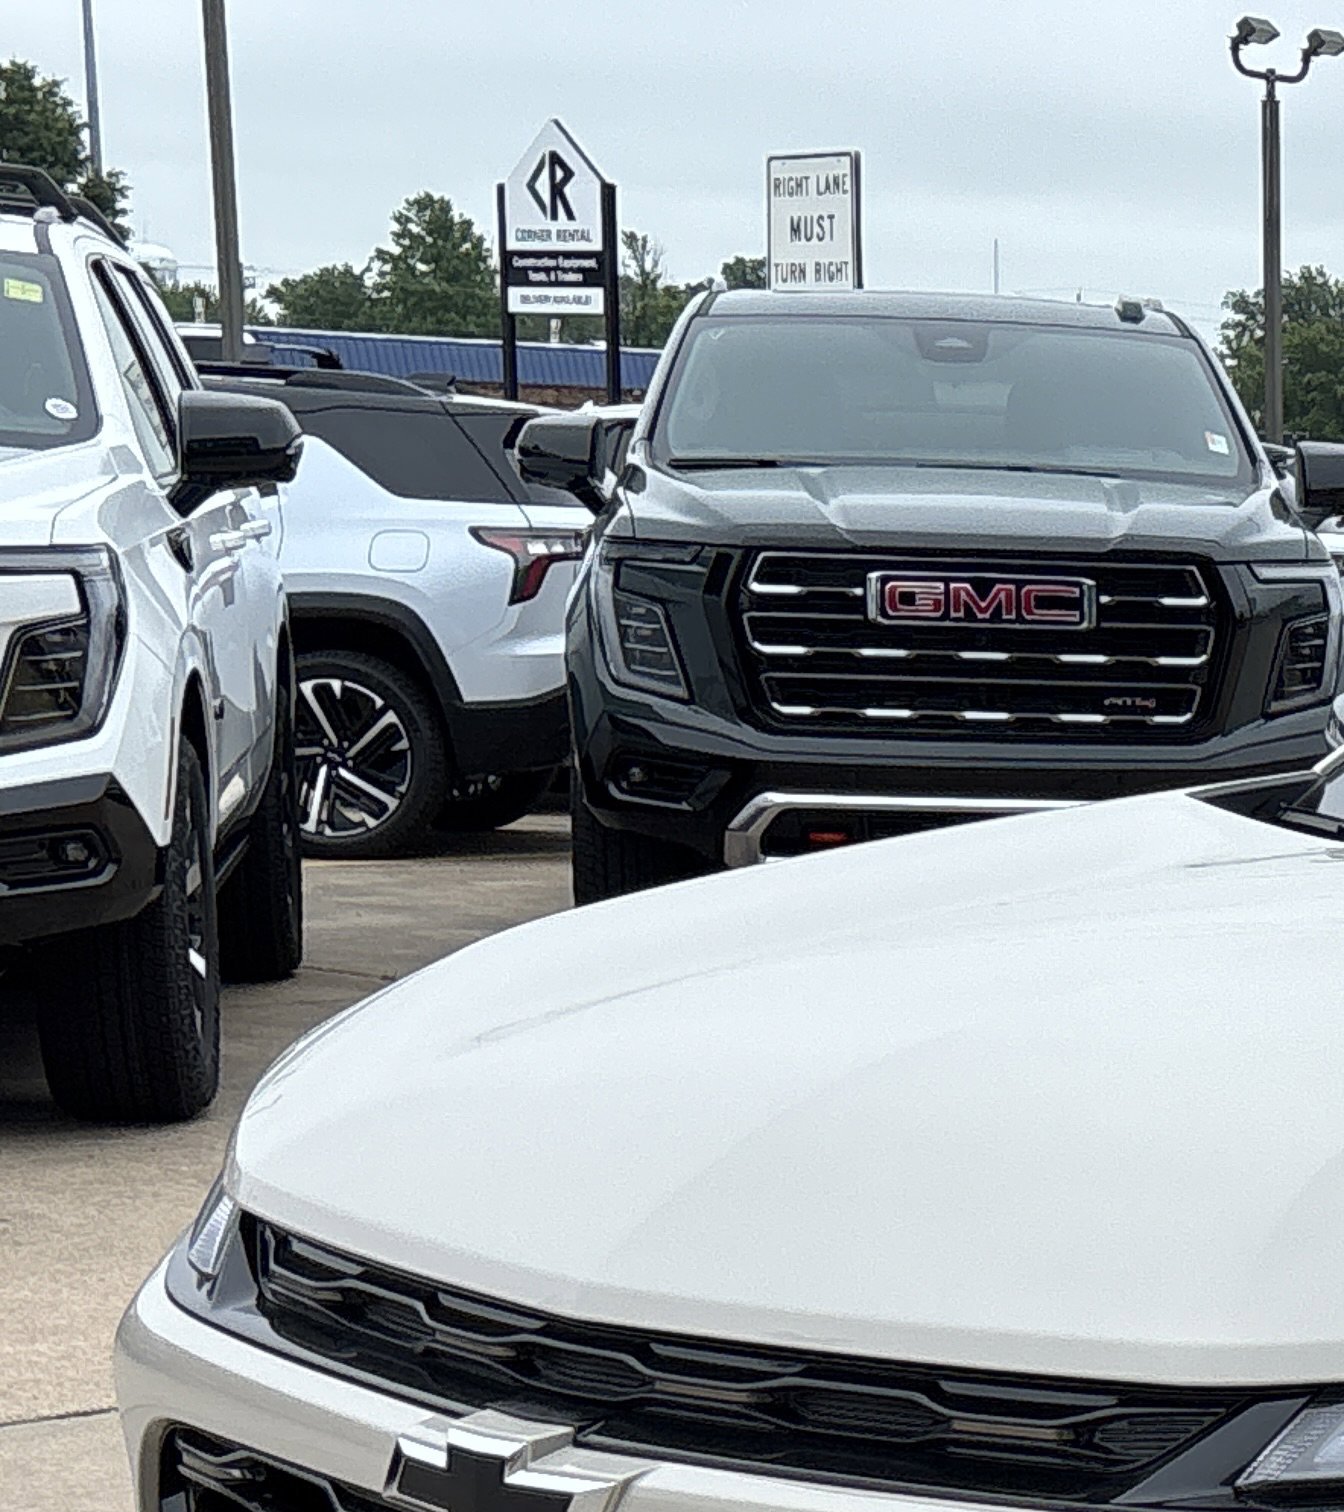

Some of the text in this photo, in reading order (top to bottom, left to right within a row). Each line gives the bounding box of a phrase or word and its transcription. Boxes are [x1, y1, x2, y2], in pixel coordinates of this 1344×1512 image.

[774, 172, 849, 198] RIGHT LANE
[556, 228, 593, 243] RENTAL
[790, 213, 835, 243] MUST
[774, 260, 849, 284] TURN RIGHT
[884, 581, 1080, 622] GMC
